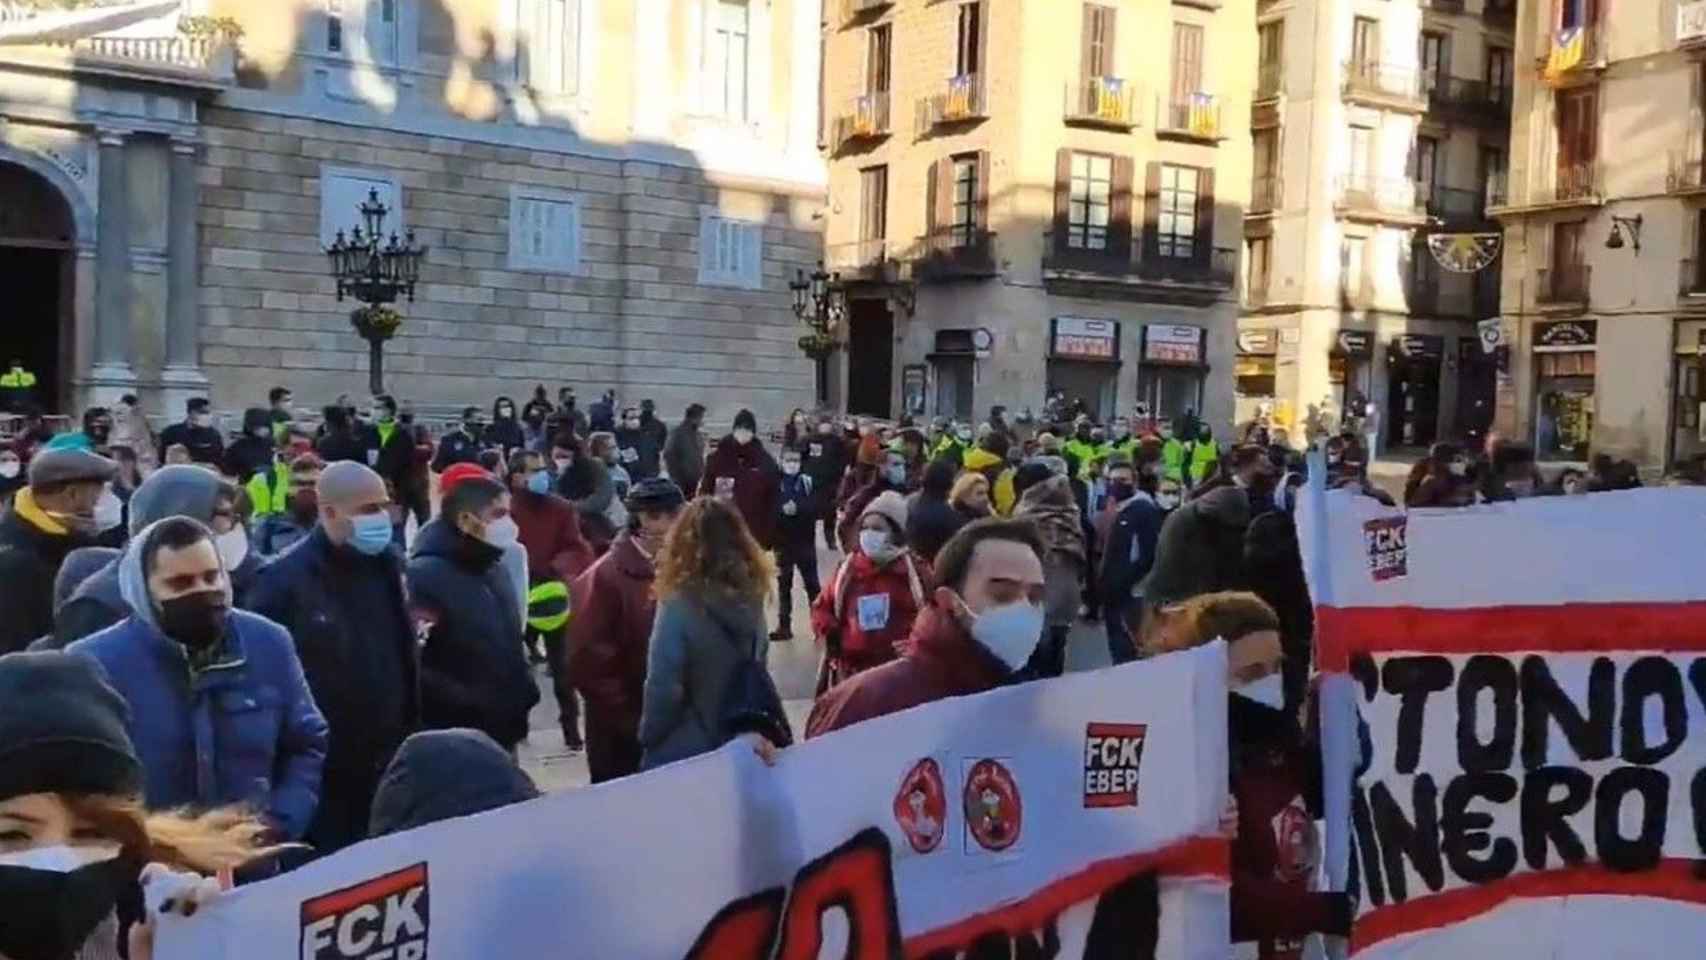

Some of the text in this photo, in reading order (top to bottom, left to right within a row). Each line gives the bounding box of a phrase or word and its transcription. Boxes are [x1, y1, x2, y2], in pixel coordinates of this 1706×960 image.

[1364, 527, 1406, 555] FCK
[1086, 736, 1142, 768] FCK
[1085, 768, 1138, 794] EBEP
[303, 885, 425, 960] FCK
